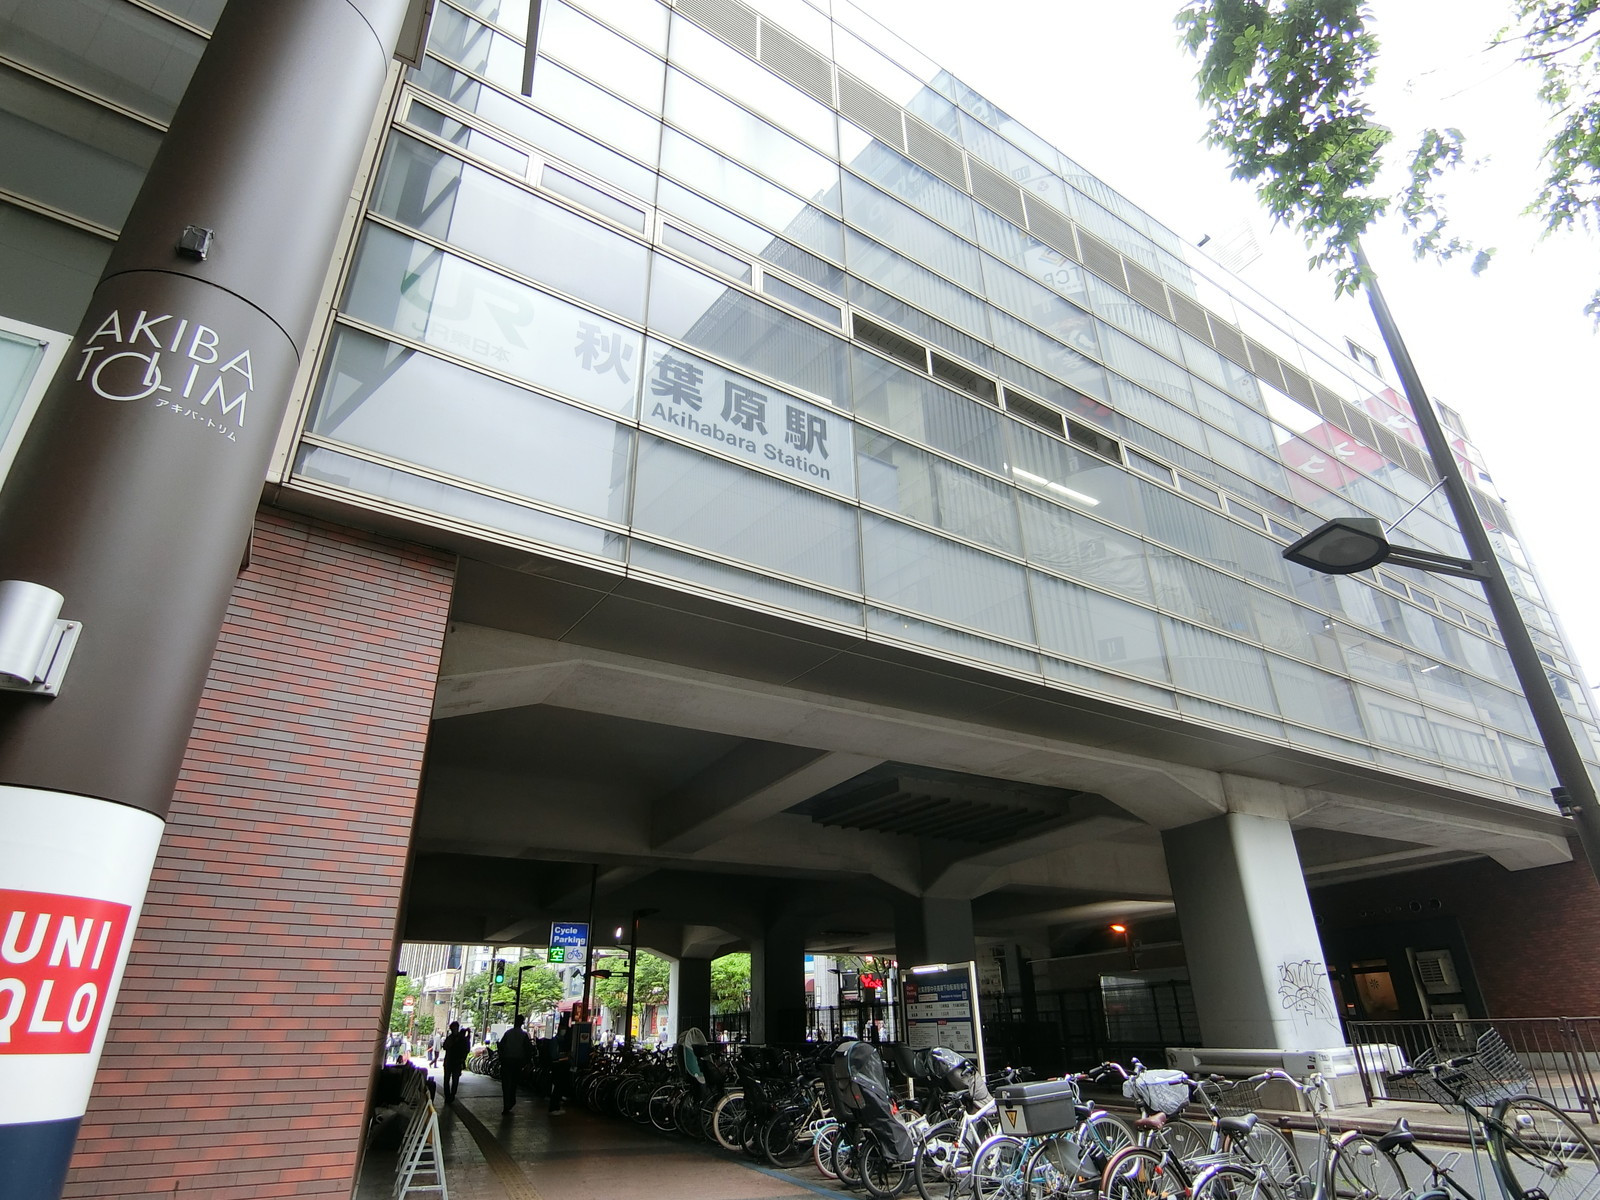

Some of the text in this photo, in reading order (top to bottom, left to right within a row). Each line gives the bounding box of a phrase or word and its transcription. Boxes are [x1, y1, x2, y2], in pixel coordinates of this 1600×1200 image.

[86, 309, 254, 391] AKIBA
[574, 320, 829, 460] 秋葉原駅
[155, 398, 237, 443] アキバ・トリム
[650, 401, 831, 481] Akihabara Station
[1, 911, 112, 970] UNI
[550, 947, 564, 961] 空
[554, 927, 578, 935] Cycle
[554, 936, 586, 945] Parking
[0, 977, 98, 1043] QLO
